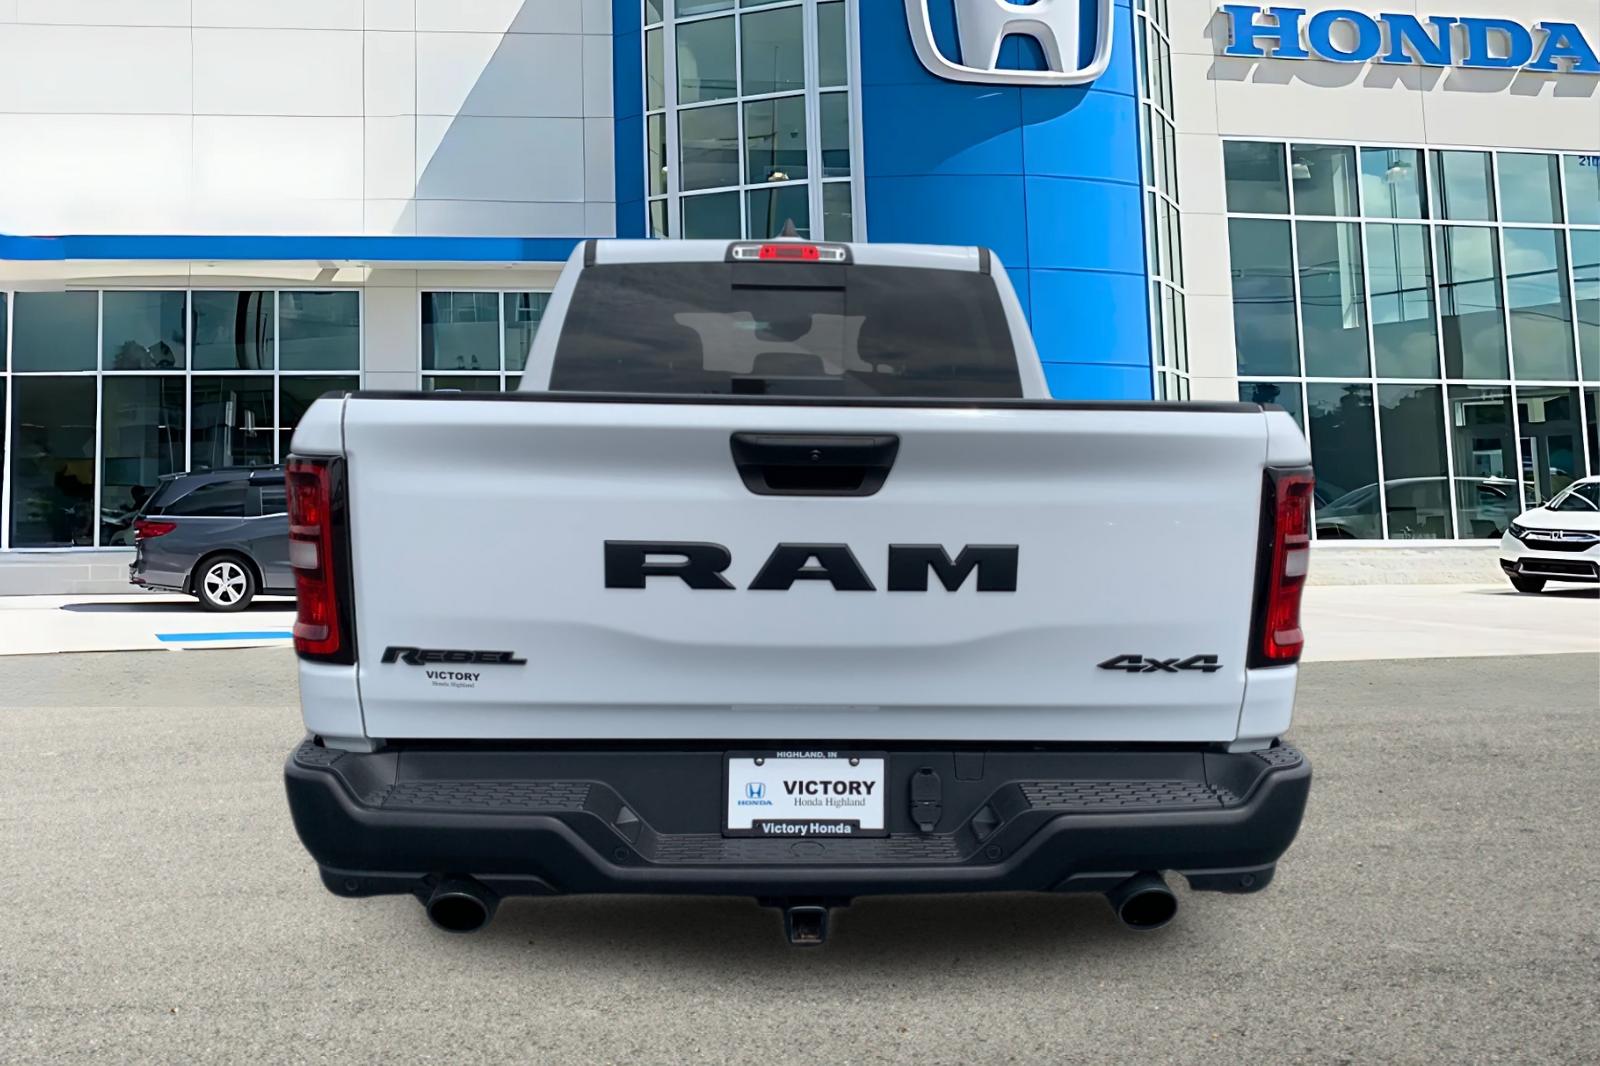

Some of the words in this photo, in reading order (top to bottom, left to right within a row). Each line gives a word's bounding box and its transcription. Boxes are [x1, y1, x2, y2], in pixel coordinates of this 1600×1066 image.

[1222, 4, 1600, 73] HONDA
[604, 540, 1019, 592] RAM
[426, 670, 480, 682] VICTORY
[776, 751, 826, 760] HIGHLAND,
[783, 780, 876, 796] VICTORY
[794, 797, 824, 807] Honda
[825, 797, 866, 808] Highland
[762, 823, 808, 836] Victory
[809, 823, 852, 834] Honda
